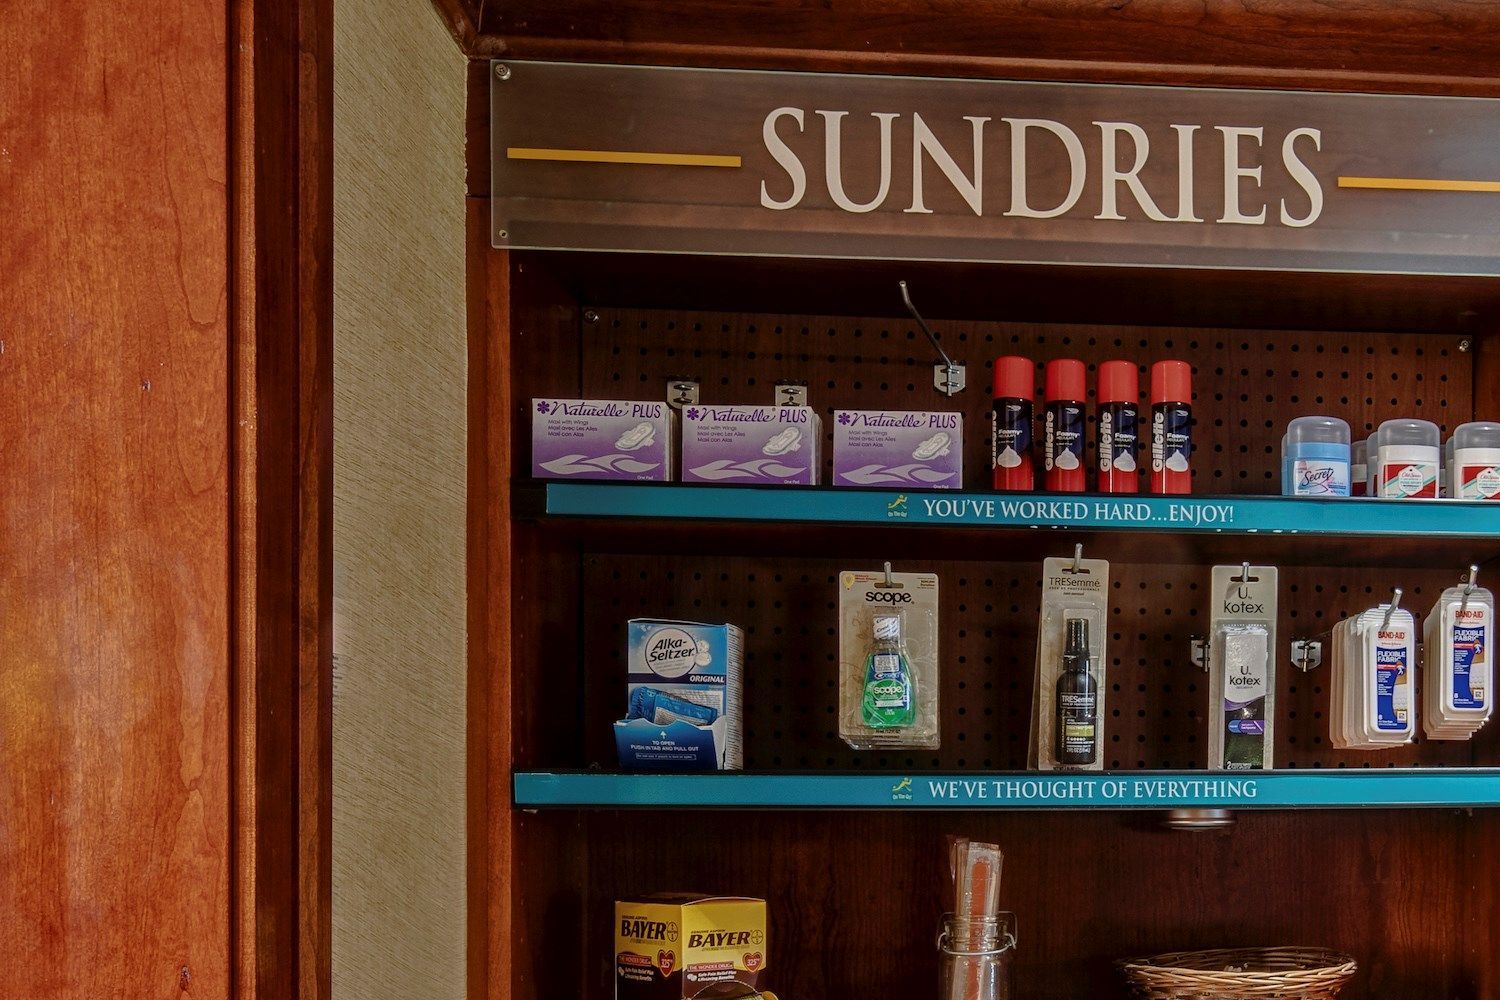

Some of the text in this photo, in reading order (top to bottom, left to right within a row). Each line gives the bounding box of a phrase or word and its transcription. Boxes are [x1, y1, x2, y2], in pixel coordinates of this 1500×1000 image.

[758, 106, 1324, 227] SUNDRIES
[550, 401, 660, 418] Naturelle PLUS
[700, 407, 807, 423] Naturelle PLUS
[850, 412, 956, 429] Naturelle PLUS
[1100, 411, 1112, 472] Gillette
[1152, 412, 1164, 472] Gillette
[1302, 468, 1334, 486] Secret
[923, 499, 995, 518] YOU'VE
[1000, 501, 1088, 520] WORKED
[1049, 577, 1101, 587] TRESemmé
[866, 592, 911, 605] scope
[1238, 587, 1247, 599] U
[1224, 600, 1262, 613] kotex
[653, 639, 687, 650] Alka-
[649, 647, 694, 662] Seltzer
[1240, 666, 1248, 675] U
[690, 675, 725, 683] ORIGINAL
[1230, 675, 1260, 685] kotex
[874, 686, 902, 695] scope
[928, 780, 1257, 799] WE'VE THOUGHT OF EVERYTHING
[621, 920, 666, 940] BAYER
[688, 931, 751, 949] BAYER
